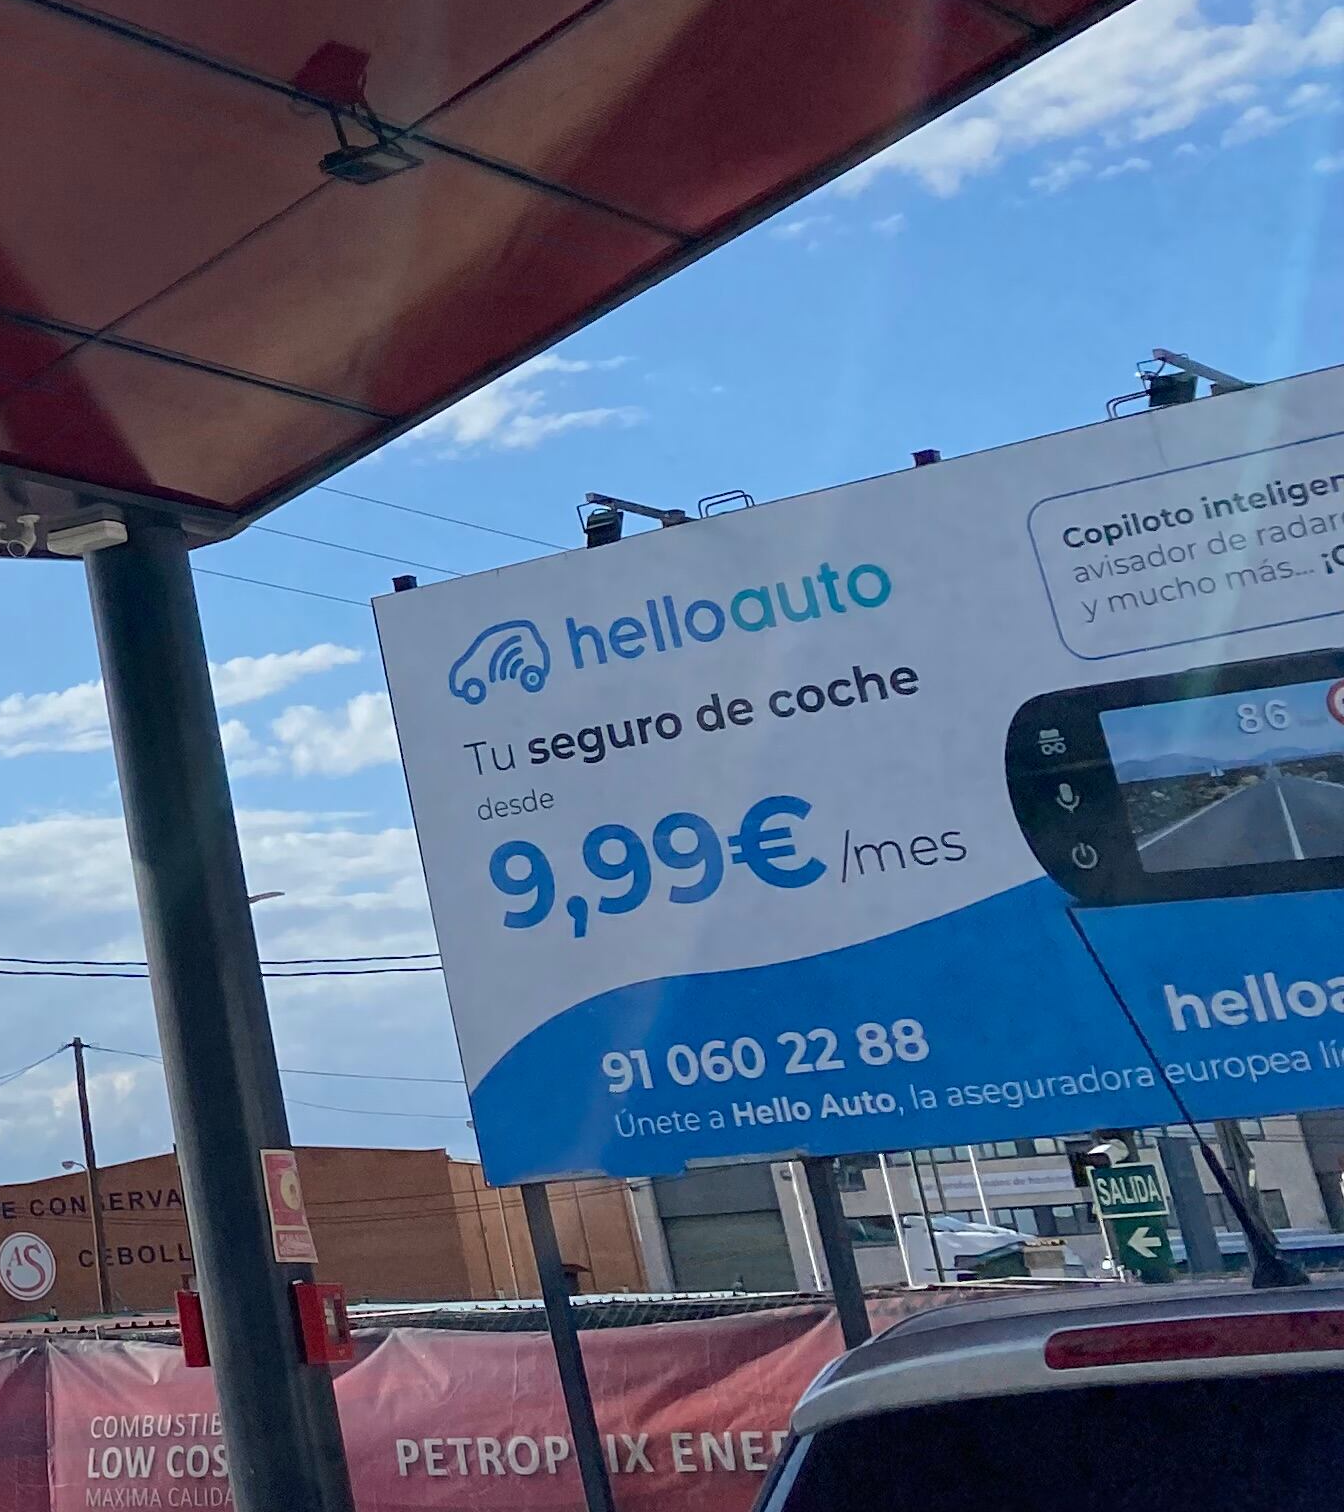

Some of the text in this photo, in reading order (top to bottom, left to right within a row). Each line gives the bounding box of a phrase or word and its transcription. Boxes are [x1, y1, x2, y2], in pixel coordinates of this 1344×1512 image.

[1063, 473, 1344, 548] Copiloto inteligen
[1075, 513, 1344, 584] avisador de radar
[566, 561, 892, 669] helloauto
[1082, 601, 1098, 623] y
[1108, 574, 1217, 613] mucho
[464, 663, 920, 776] Tu seguro de coche
[1237, 699, 1289, 733] 86
[477, 788, 555, 821] desde
[489, 794, 968, 938] 9,99€ /mes
[602, 1018, 930, 1094] 91 060 22 88
[614, 1109, 701, 1137] Únete
[709, 1111, 726, 1129] a
[732, 1097, 811, 1128] Hello
[820, 1090, 903, 1119] Auto,
[911, 1084, 937, 1109] la
[948, 1065, 1155, 1109] aseguradora
[1165, 1051, 1312, 1084] europea
[29, 1189, 183, 1218] CONERVA
[1096, 1174, 1160, 1207] SALIDA
[90, 1412, 224, 1439] COMBUSTIB
[87, 1444, 229, 1479] LOW COS
[396, 1431, 655, 1478] PETROPIX
[85, 1487, 235, 1508] MAXIMA CALIDA
